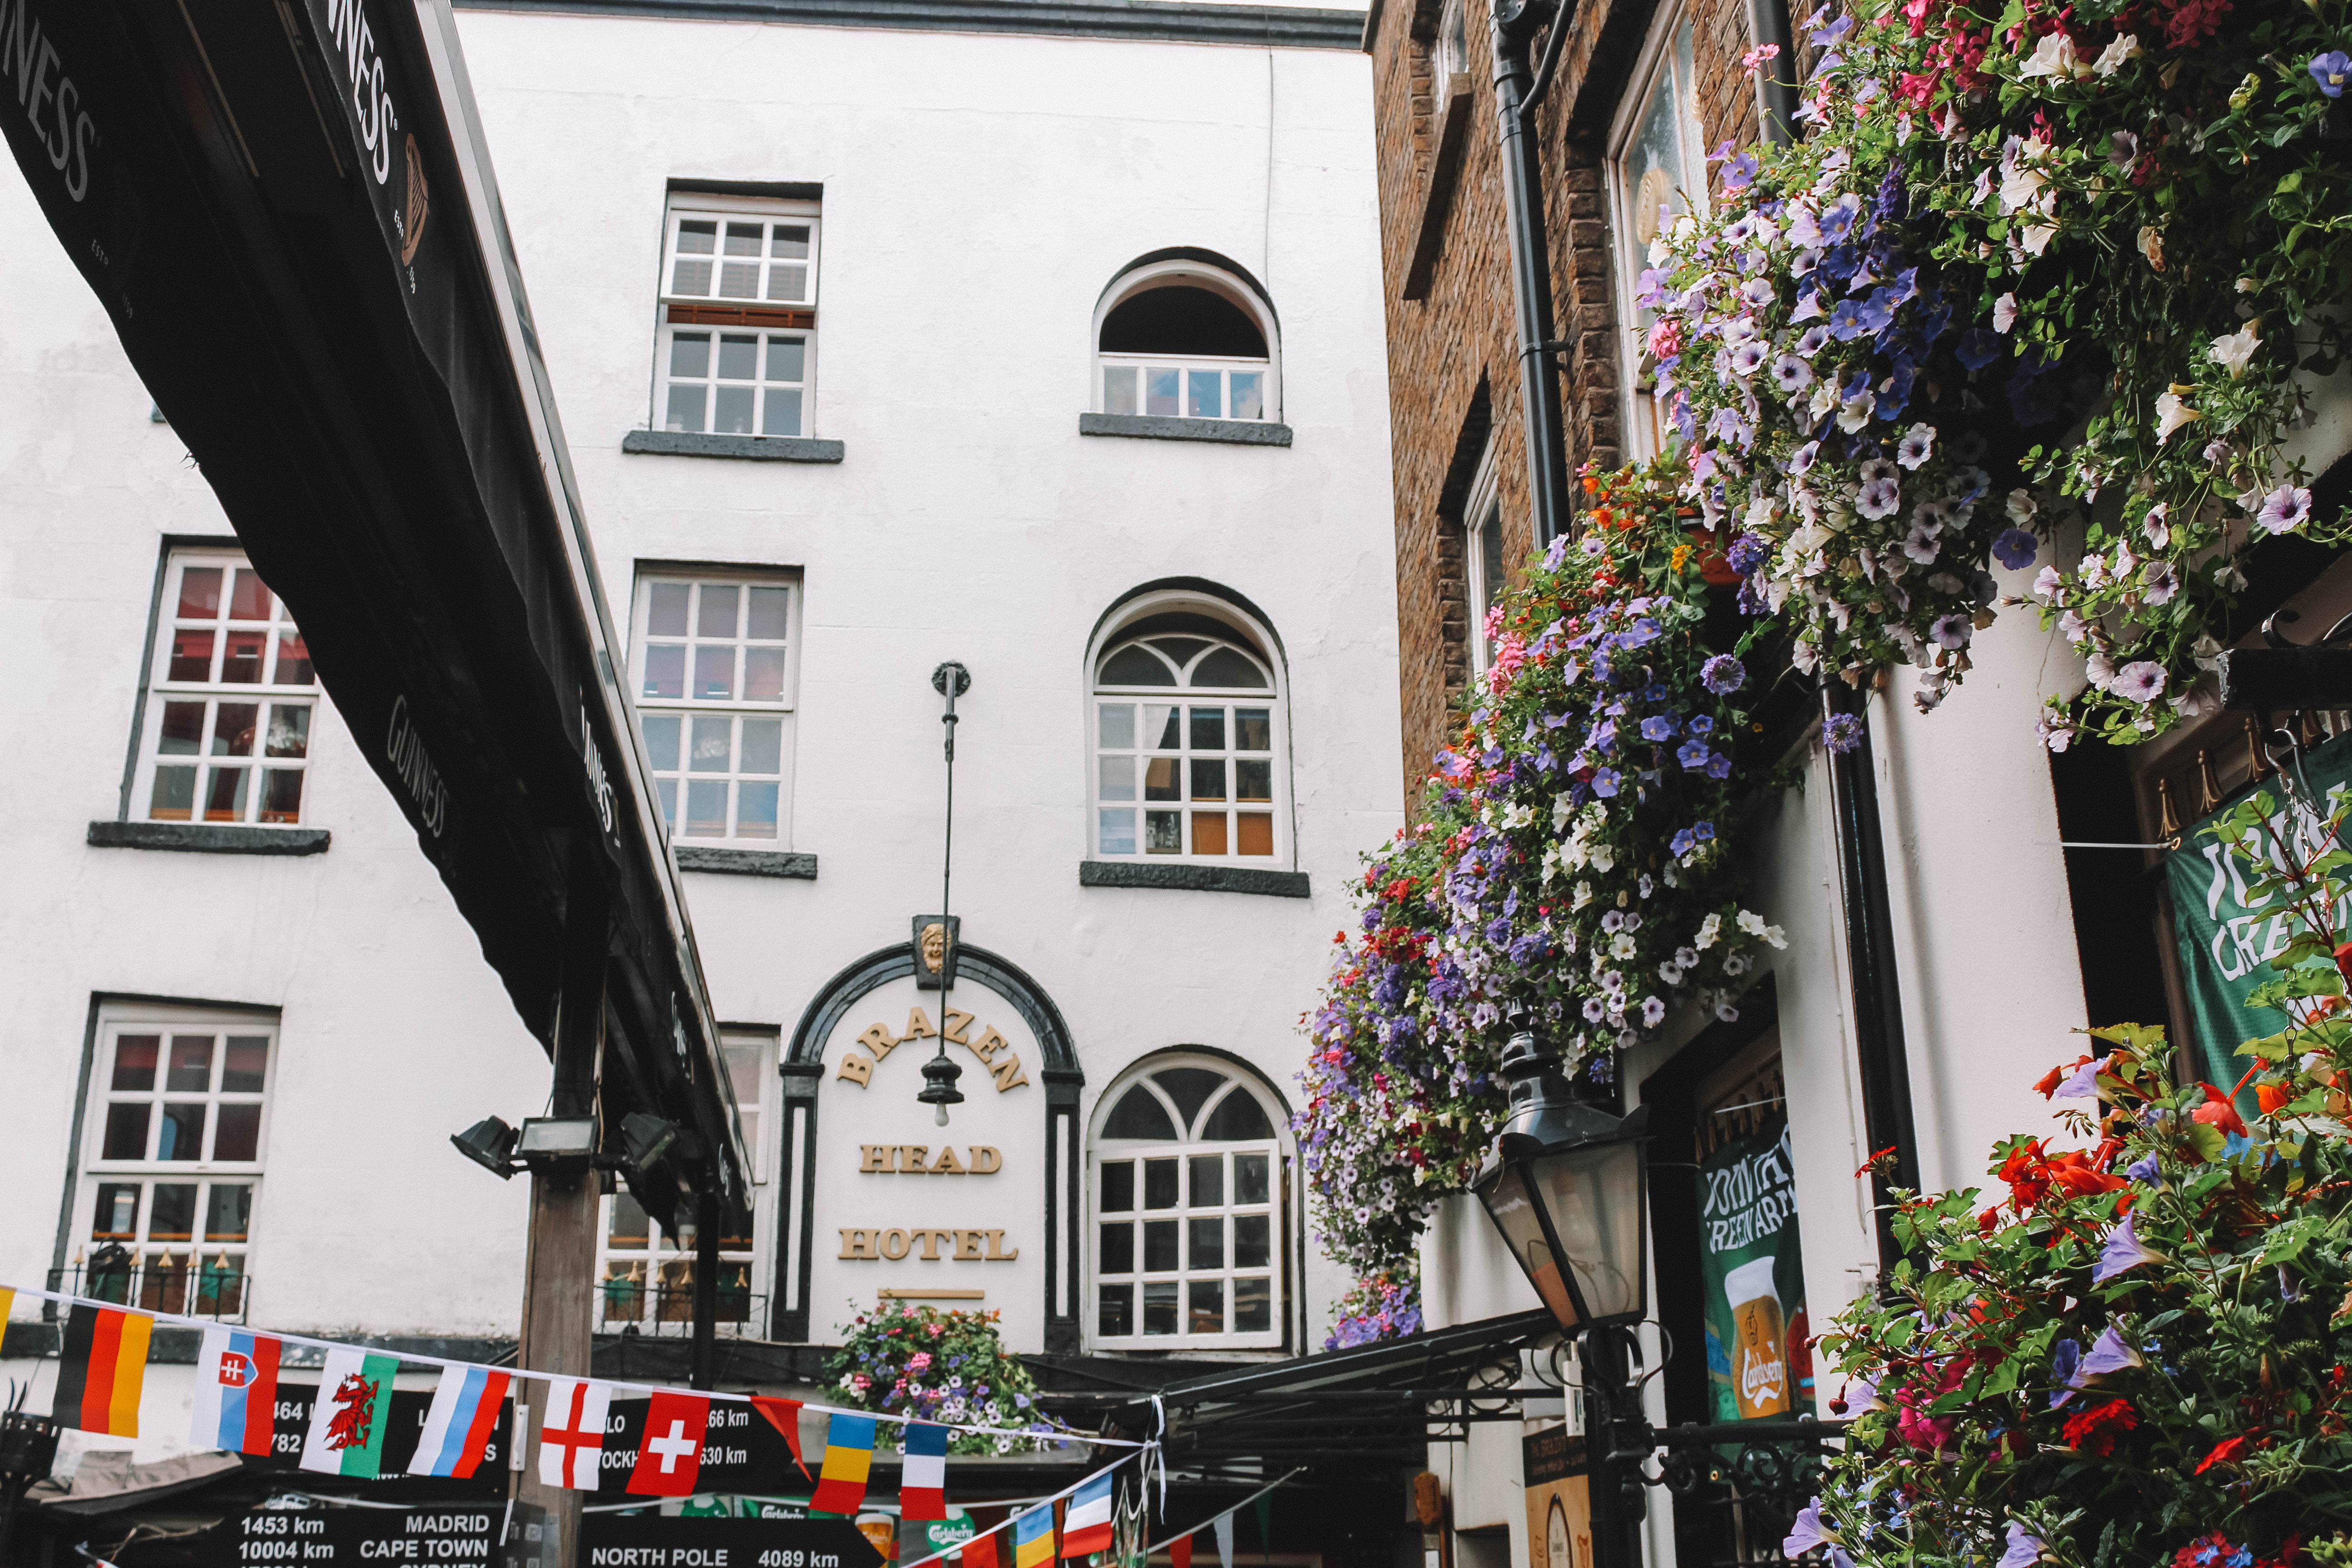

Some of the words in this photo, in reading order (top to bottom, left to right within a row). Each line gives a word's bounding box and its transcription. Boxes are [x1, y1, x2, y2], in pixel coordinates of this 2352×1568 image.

[0, 0, 95, 202] NESS
[387, 694, 451, 838] GUINNESS
[836, 1006, 1029, 1093] BRAZEN
[859, 1145, 1002, 1174] HEAD
[838, 1228, 1019, 1261] HOTEL
[706, 1409, 724, 1428] 66
[728, 1409, 749, 1427] km
[601, 1450, 639, 1469] OCKH
[726, 1446, 747, 1464] km
[241, 1516, 288, 1534] 1453
[294, 1516, 325, 1534] km
[405, 1515, 490, 1533] MADRID
[239, 1541, 298, 1560] 10004
[304, 1541, 334, 1559] km
[360, 1540, 419, 1558] CAPE
[425, 1539, 488, 1558] TOWN
[592, 1548, 666, 1567] NORTH
[672, 1548, 728, 1567] POLE
[758, 1550, 804, 1568] 4089
[809, 1551, 839, 1568] km
